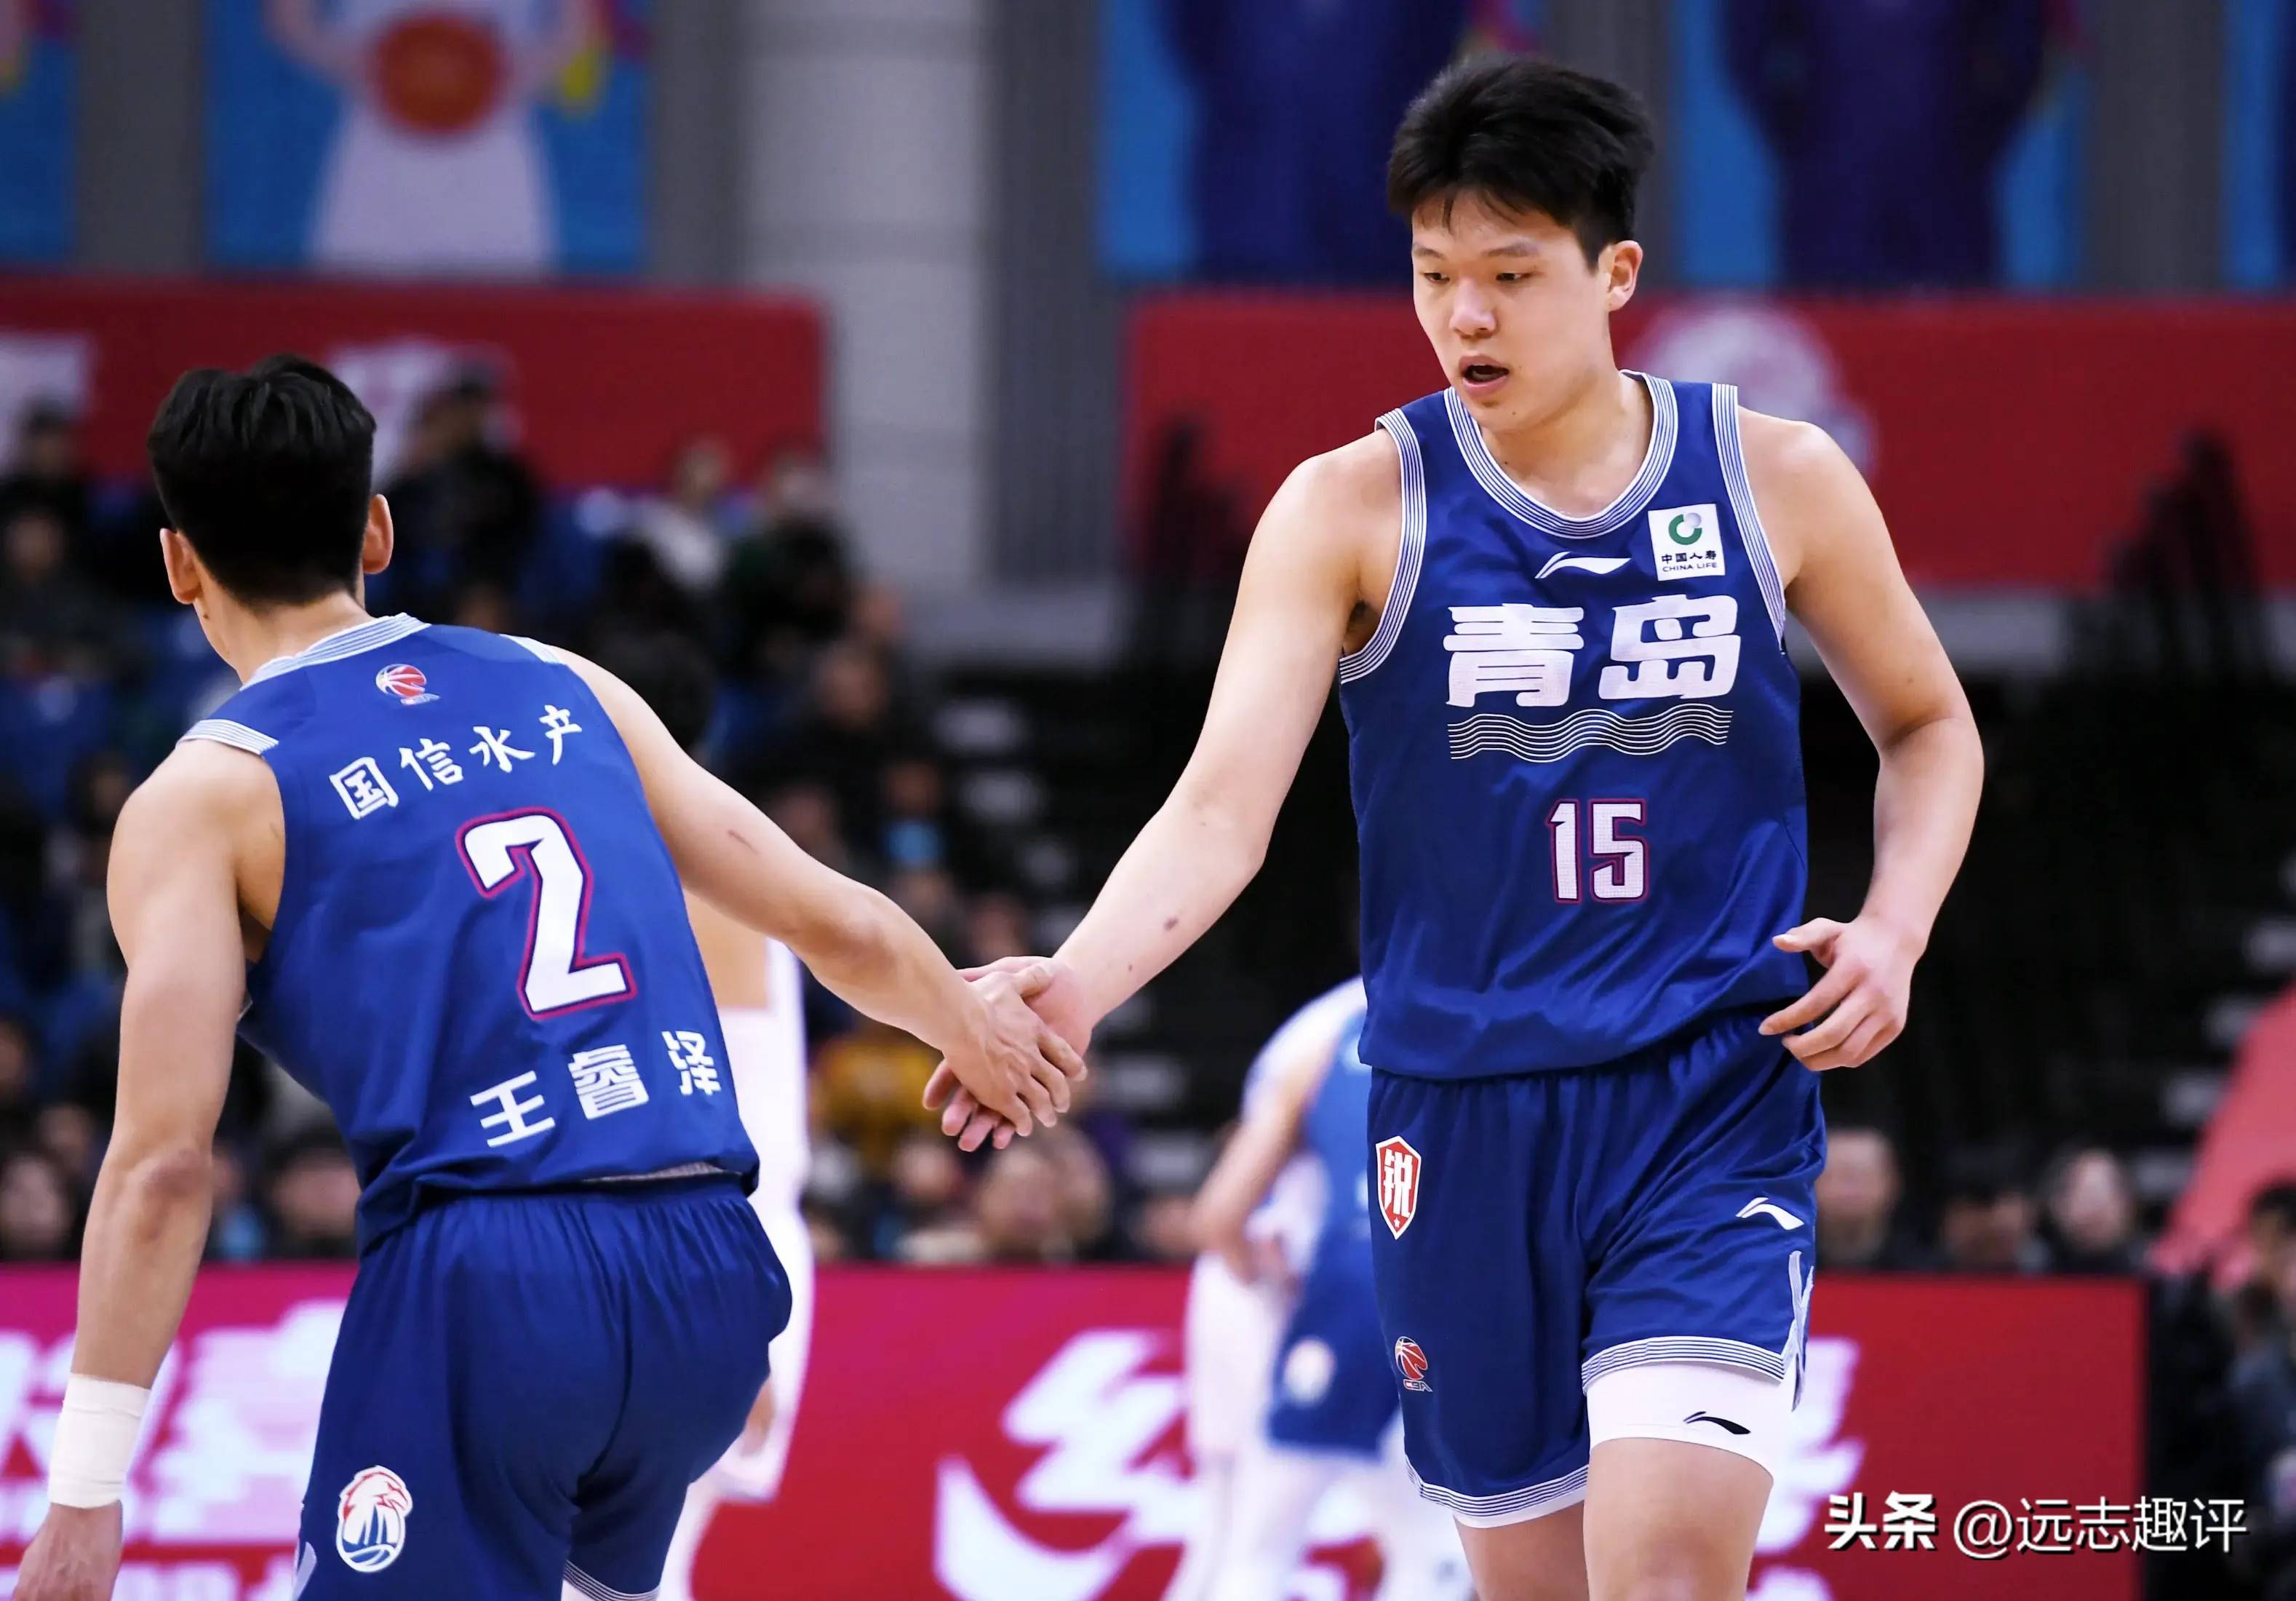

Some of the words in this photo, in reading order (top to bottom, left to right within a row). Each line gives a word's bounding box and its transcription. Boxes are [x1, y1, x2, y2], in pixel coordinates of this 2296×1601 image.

[1662, 550, 1717, 564] 中国人寿
[1662, 564, 1694, 572] CHINA
[1443, 595, 1741, 707] 青岛
[329, 704, 582, 819] 国信水产
[1546, 799, 1649, 902] 15
[457, 807, 636, 1018] 2
[470, 1030, 721, 1148] 王睿泽
